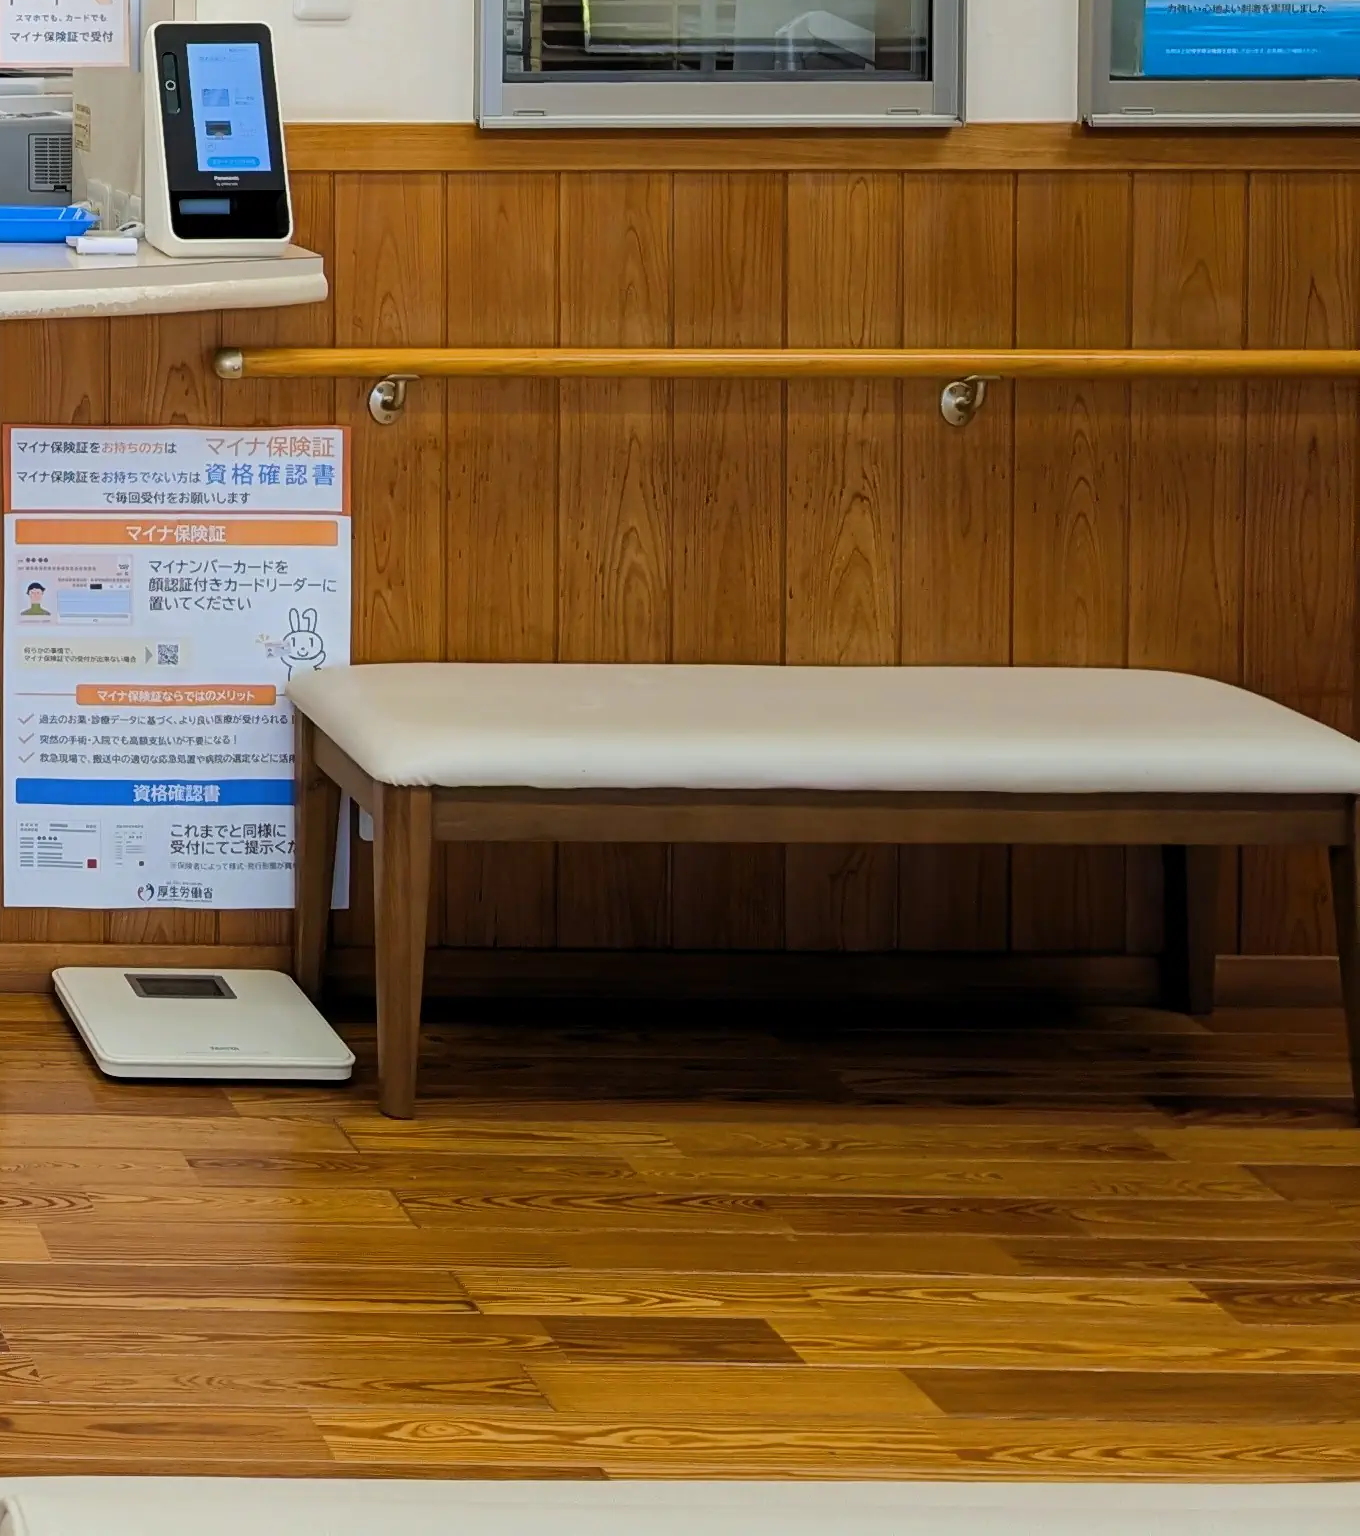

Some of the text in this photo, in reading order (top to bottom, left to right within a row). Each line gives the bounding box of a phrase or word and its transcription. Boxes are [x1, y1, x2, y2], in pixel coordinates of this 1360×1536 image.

[10, 31, 114, 42] マイナ保険証で受付
[17, 436, 335, 458] マイナ保険証をお持ちの方は マイナ保険証
[17, 463, 335, 486] マイナ保険証をお持ちでない方は 資格確認書
[103, 491, 250, 504] で毎回受付をお願いします
[126, 525, 226, 543] マイナ保険証
[149, 560, 288, 574] マイナンバーカードを
[149, 577, 337, 592] 顔認証付きカードリーダーに
[149, 595, 252, 611] 置いてください
[134, 784, 220, 802] 資格確認書
[171, 824, 286, 838] これまでと同様に
[158, 886, 213, 899] 厚生労働省
